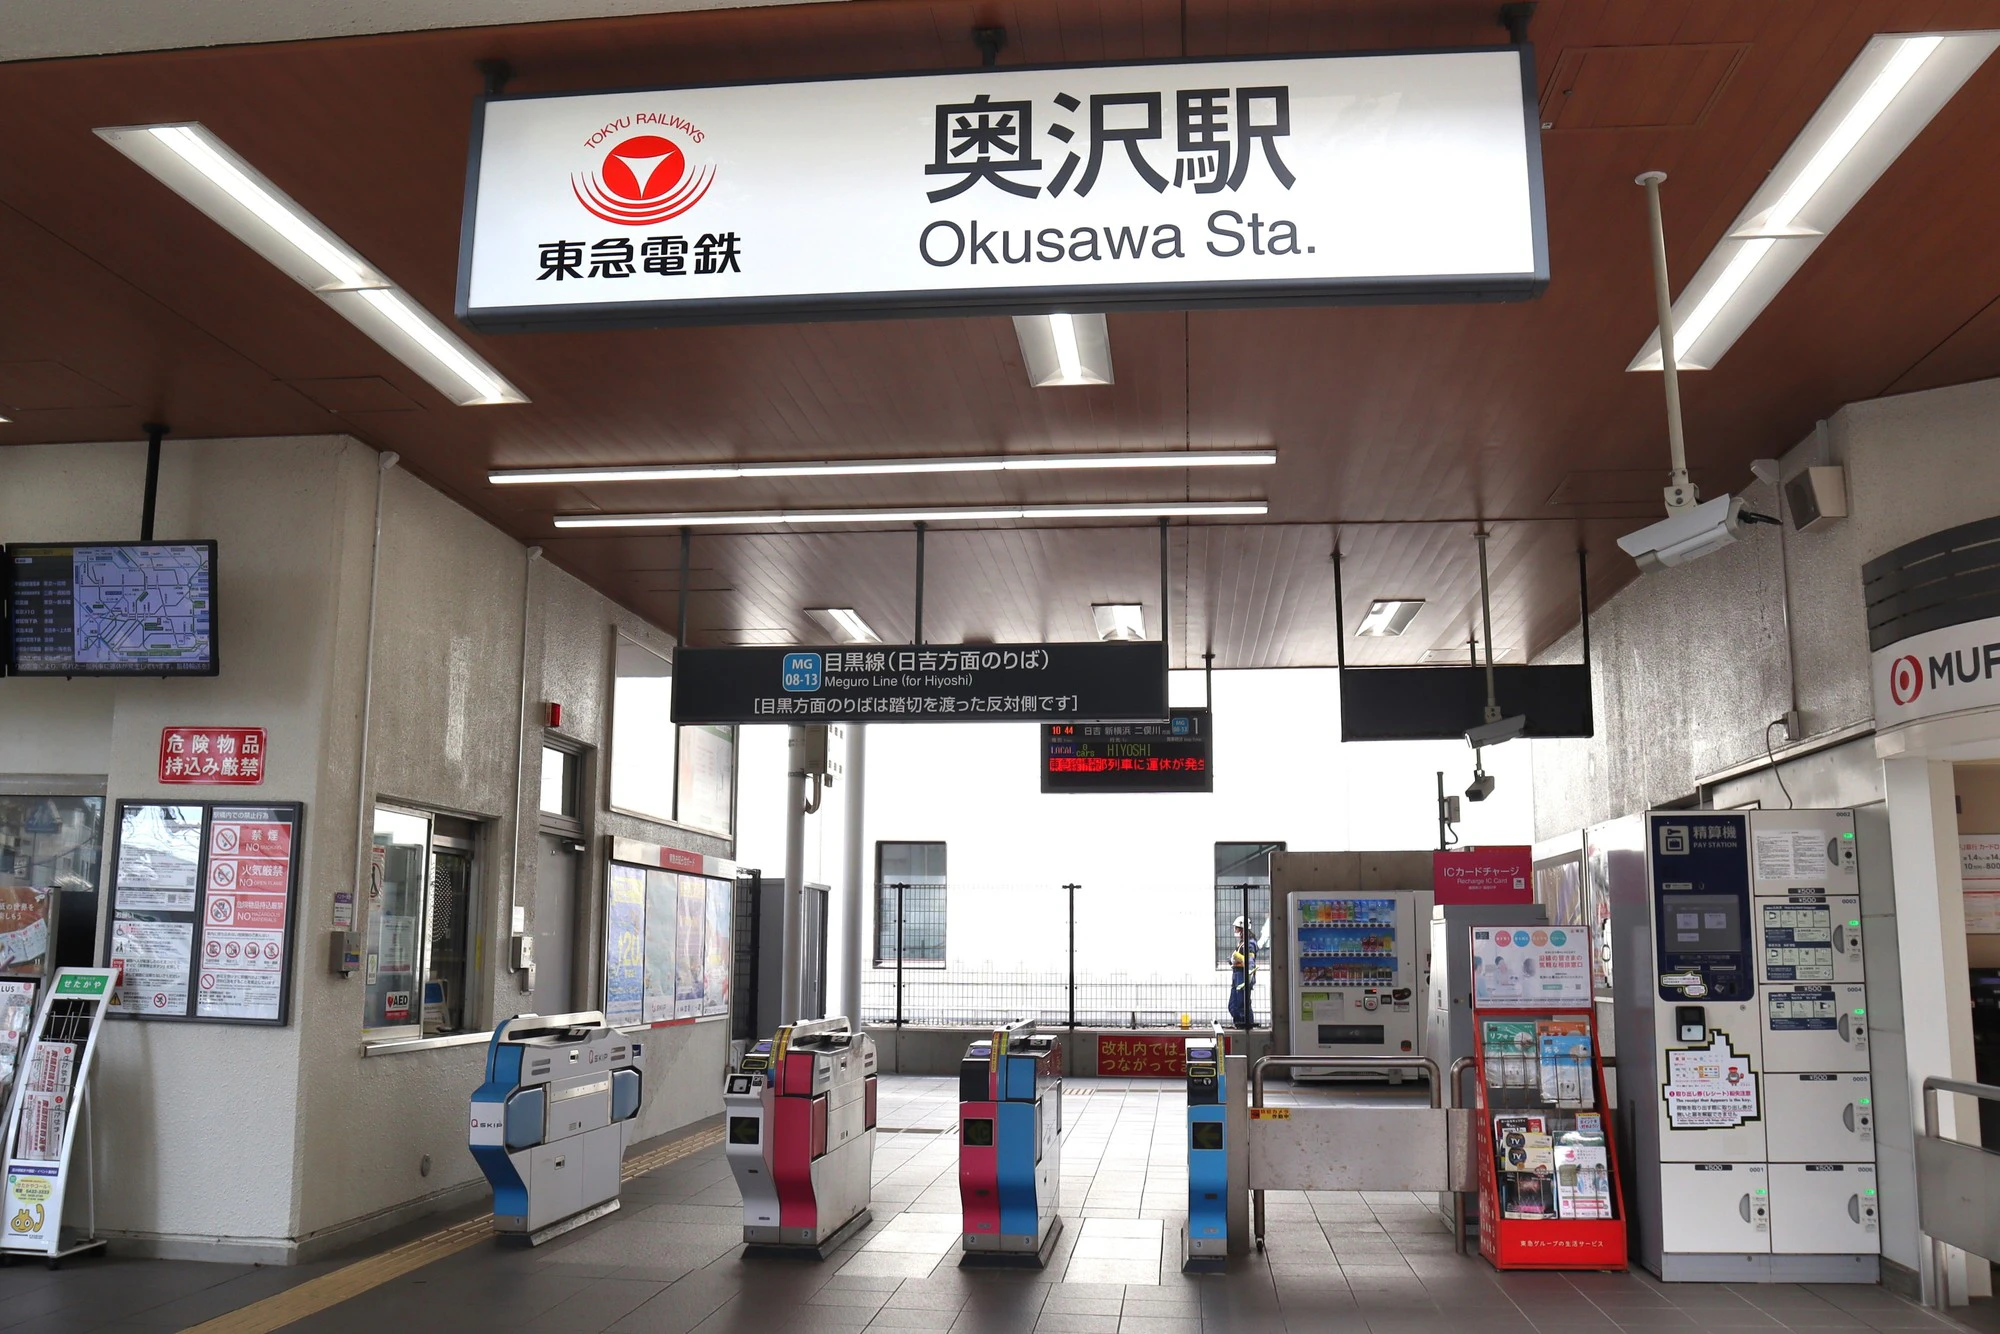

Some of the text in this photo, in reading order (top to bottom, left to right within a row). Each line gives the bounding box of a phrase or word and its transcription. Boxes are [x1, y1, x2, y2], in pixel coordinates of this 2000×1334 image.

[584, 112, 706, 151] TOKYU RAILWAYS
[924, 85, 1297, 204] 奥沢駅
[919, 209, 1316, 268] Okusawa Sta.
[536, 231, 741, 281] 東急電鉄
[792, 658, 813, 670] MG
[825, 650, 1050, 673] 目黒線（日吉方面のりば）
[785, 674, 818, 686] 08-13
[825, 673, 973, 688] Meguro Line (for Hiyoshi)
[754, 695, 1079, 714] [目黒方面のりばは踏切を渡った反対側です]
[1052, 726, 1074, 735] 10 44
[1084, 726, 1101, 736] 日吉
[1105, 726, 1132, 736] 新横浜
[1134, 726, 1161, 736] 二俣川
[166, 734, 260, 754] 危険物品
[1107, 744, 1151, 756] HIYOSHI
[165, 757, 259, 778] 持込み厳禁
[1692, 825, 1737, 840] 精算機
[246, 843, 260, 852] NO
[242, 865, 284, 877] 火気厳禁
[1443, 866, 1520, 877] ICカードチャージ
[240, 878, 253, 887] NO
[237, 912, 252, 920] NO
[64, 980, 102, 988] せたがや
[393, 995, 408, 1006] AED
[1102, 1040, 1186, 1057] 改札内では
